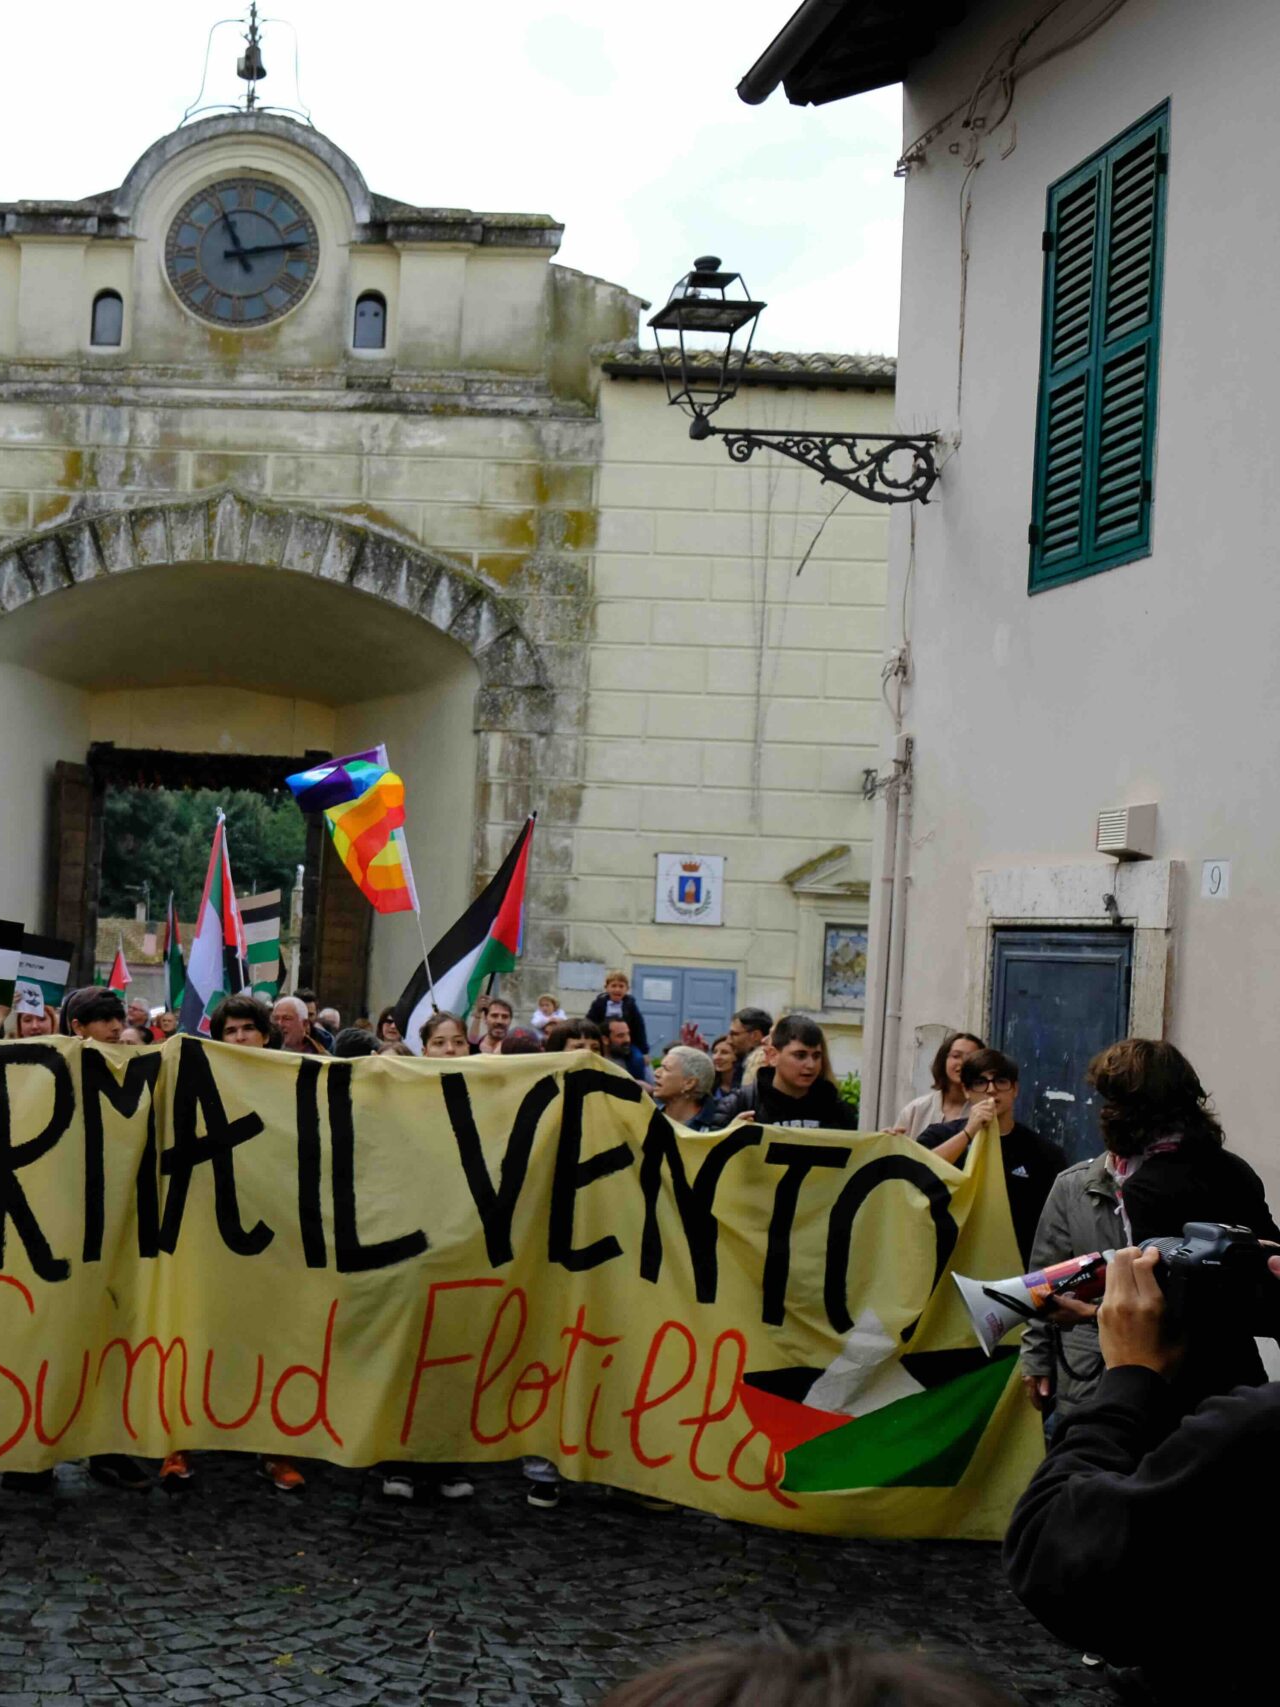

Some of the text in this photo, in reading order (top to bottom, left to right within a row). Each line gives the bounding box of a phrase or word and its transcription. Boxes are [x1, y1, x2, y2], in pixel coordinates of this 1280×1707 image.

[1209, 865, 1222, 895] 9
[295, 1056, 429, 1274] IL
[440, 1067, 959, 1343] VENTO
[400, 1278, 801, 1510] Flotilla
